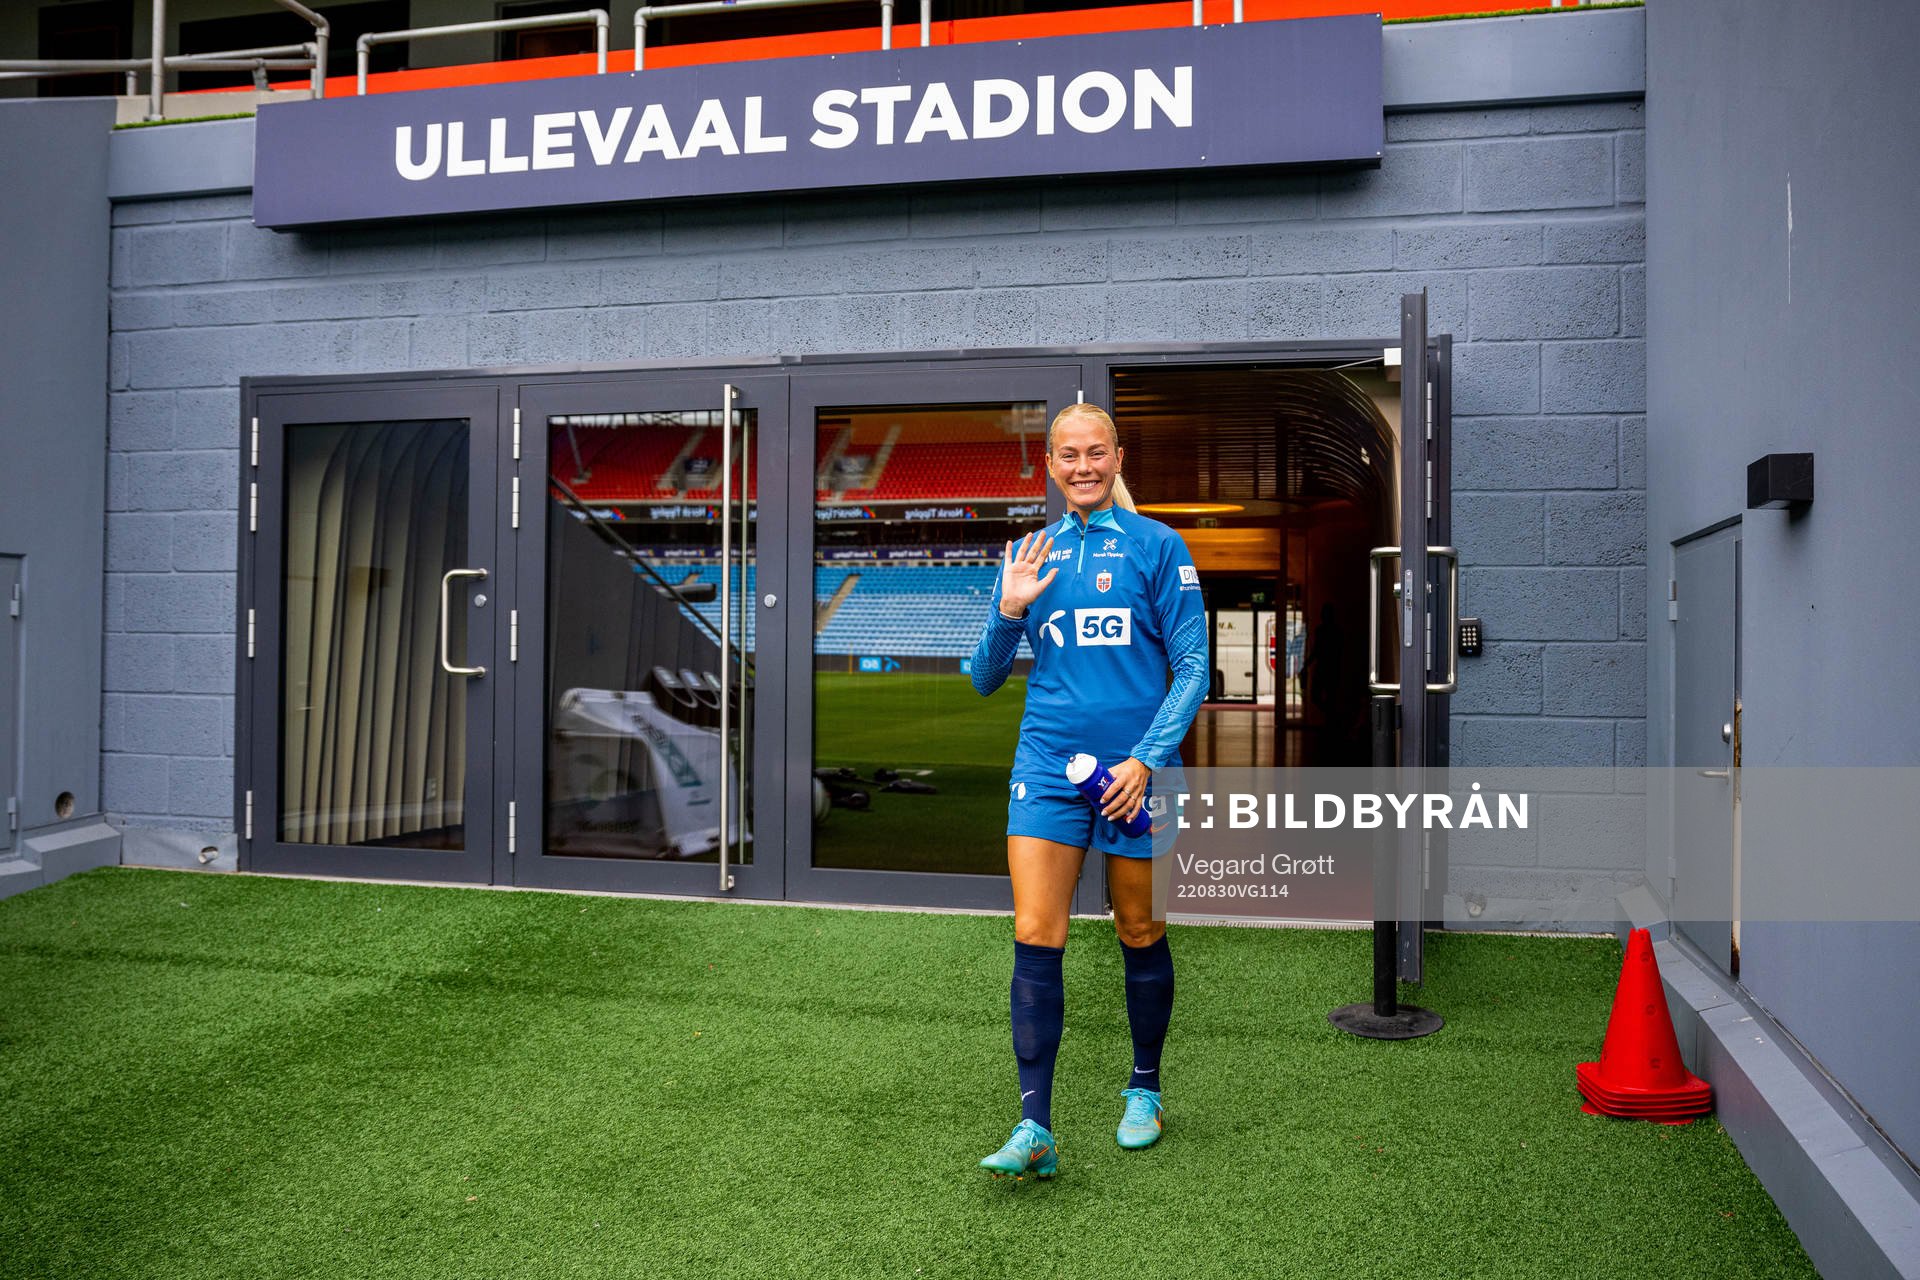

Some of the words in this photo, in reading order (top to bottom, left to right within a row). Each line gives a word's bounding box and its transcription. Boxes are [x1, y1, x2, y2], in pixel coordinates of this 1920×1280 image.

[395, 96, 787, 181] ULLEVAAL
[810, 66, 1193, 149] STADION
[1082, 615, 1124, 638] 5G
